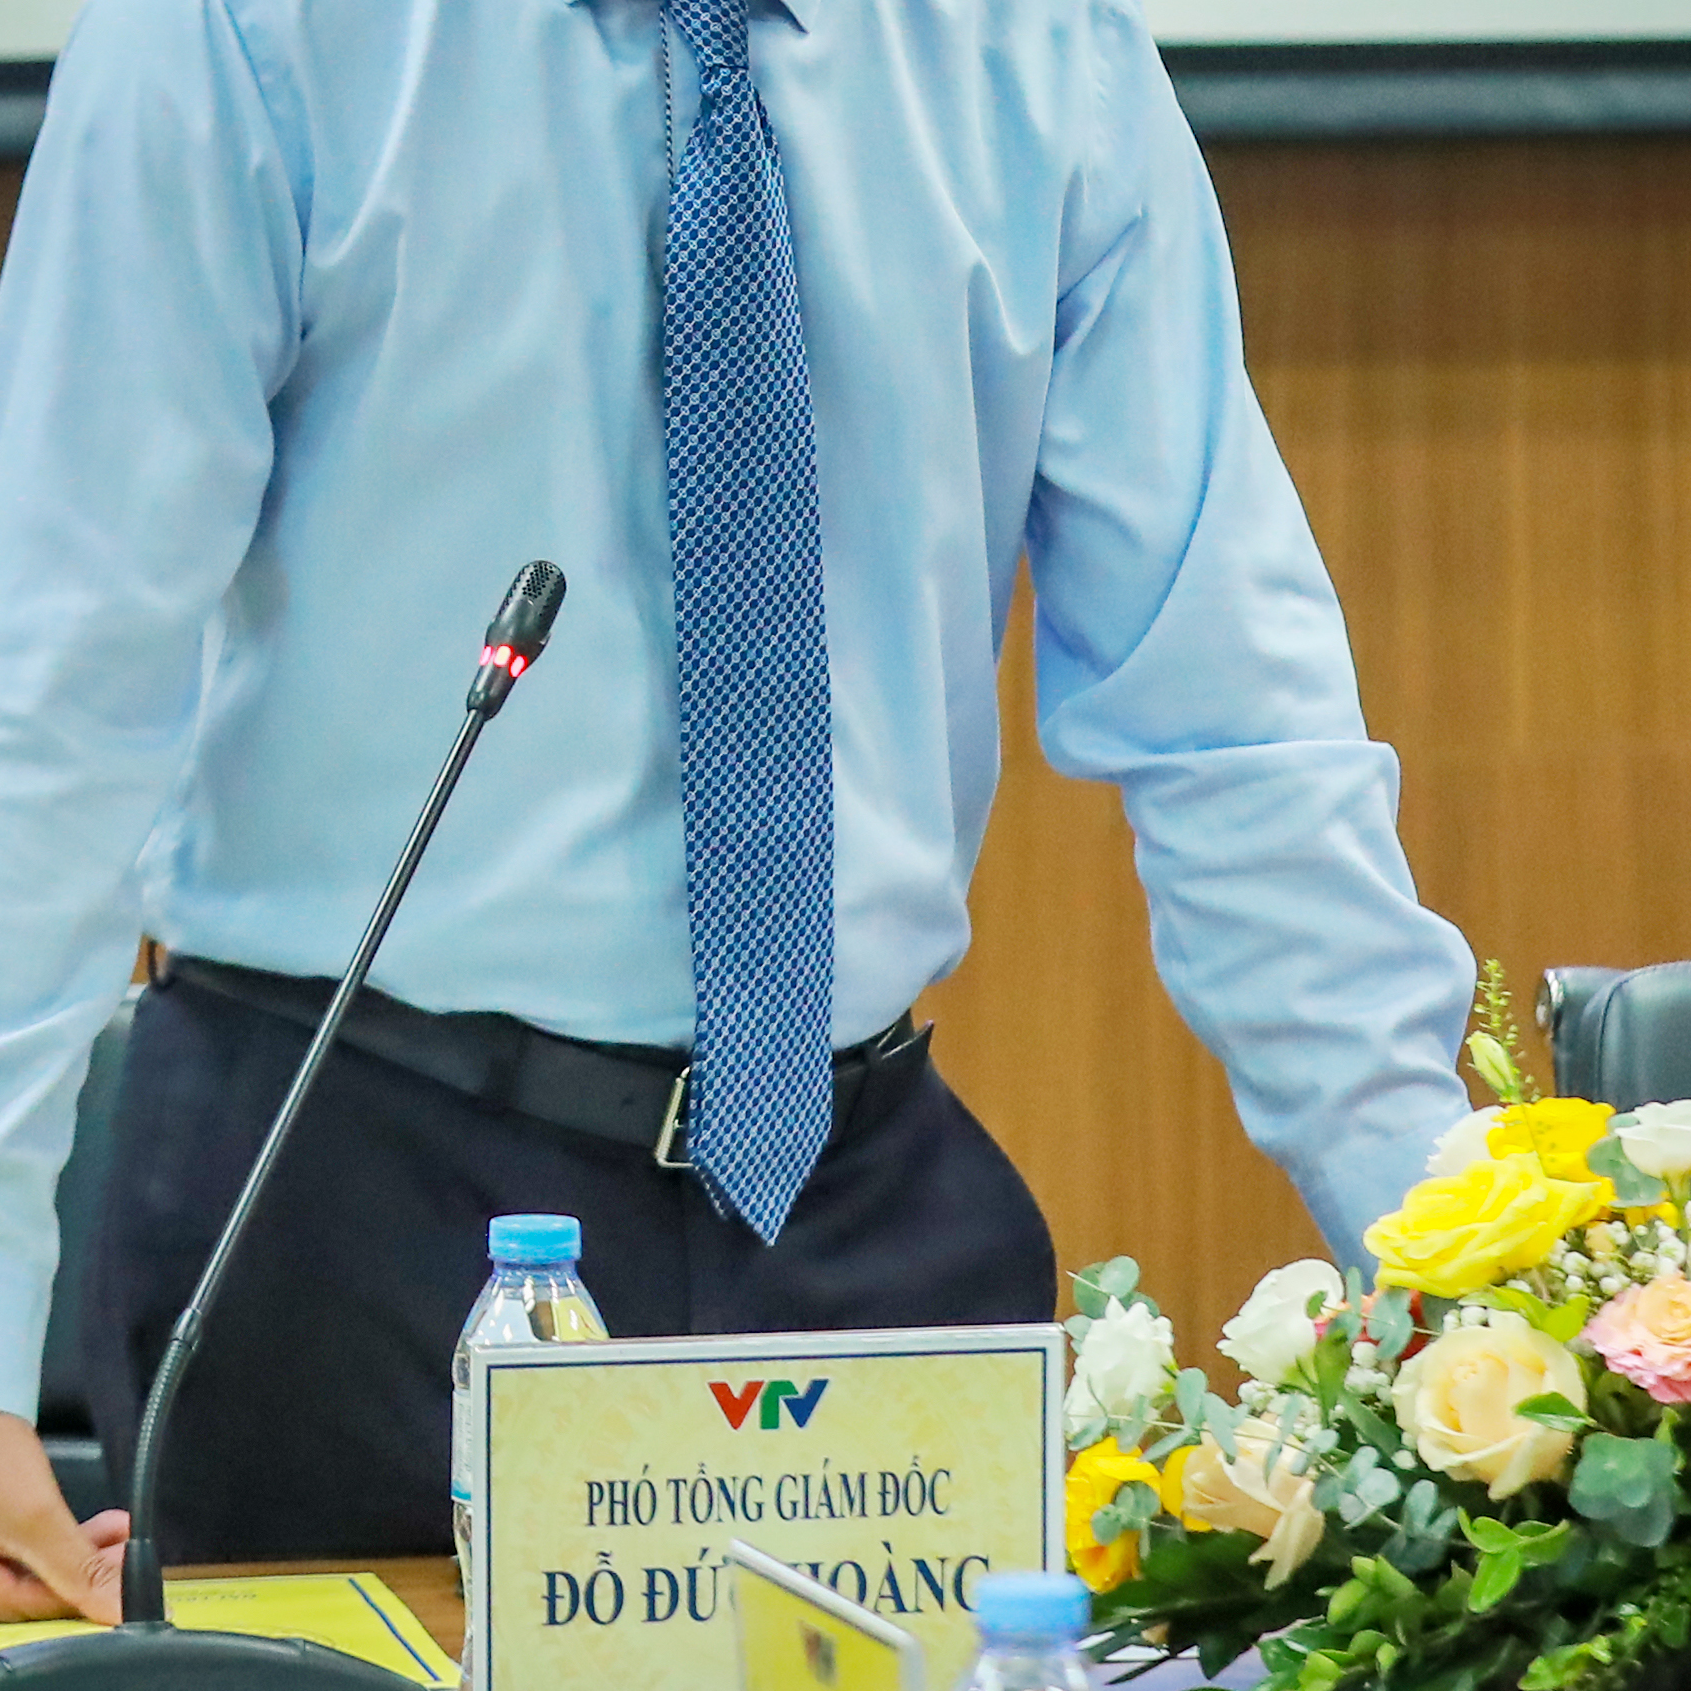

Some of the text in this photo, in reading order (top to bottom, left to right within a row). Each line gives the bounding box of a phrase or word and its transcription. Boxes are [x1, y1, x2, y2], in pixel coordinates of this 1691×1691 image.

[709, 1379, 829, 1429] VTV
[585, 1454, 951, 1526] PHÓ TỔNG GIÁM ĐỐC
[542, 1551, 624, 1626] ĐỖ
[641, 1547, 736, 1623] ĐỨ
